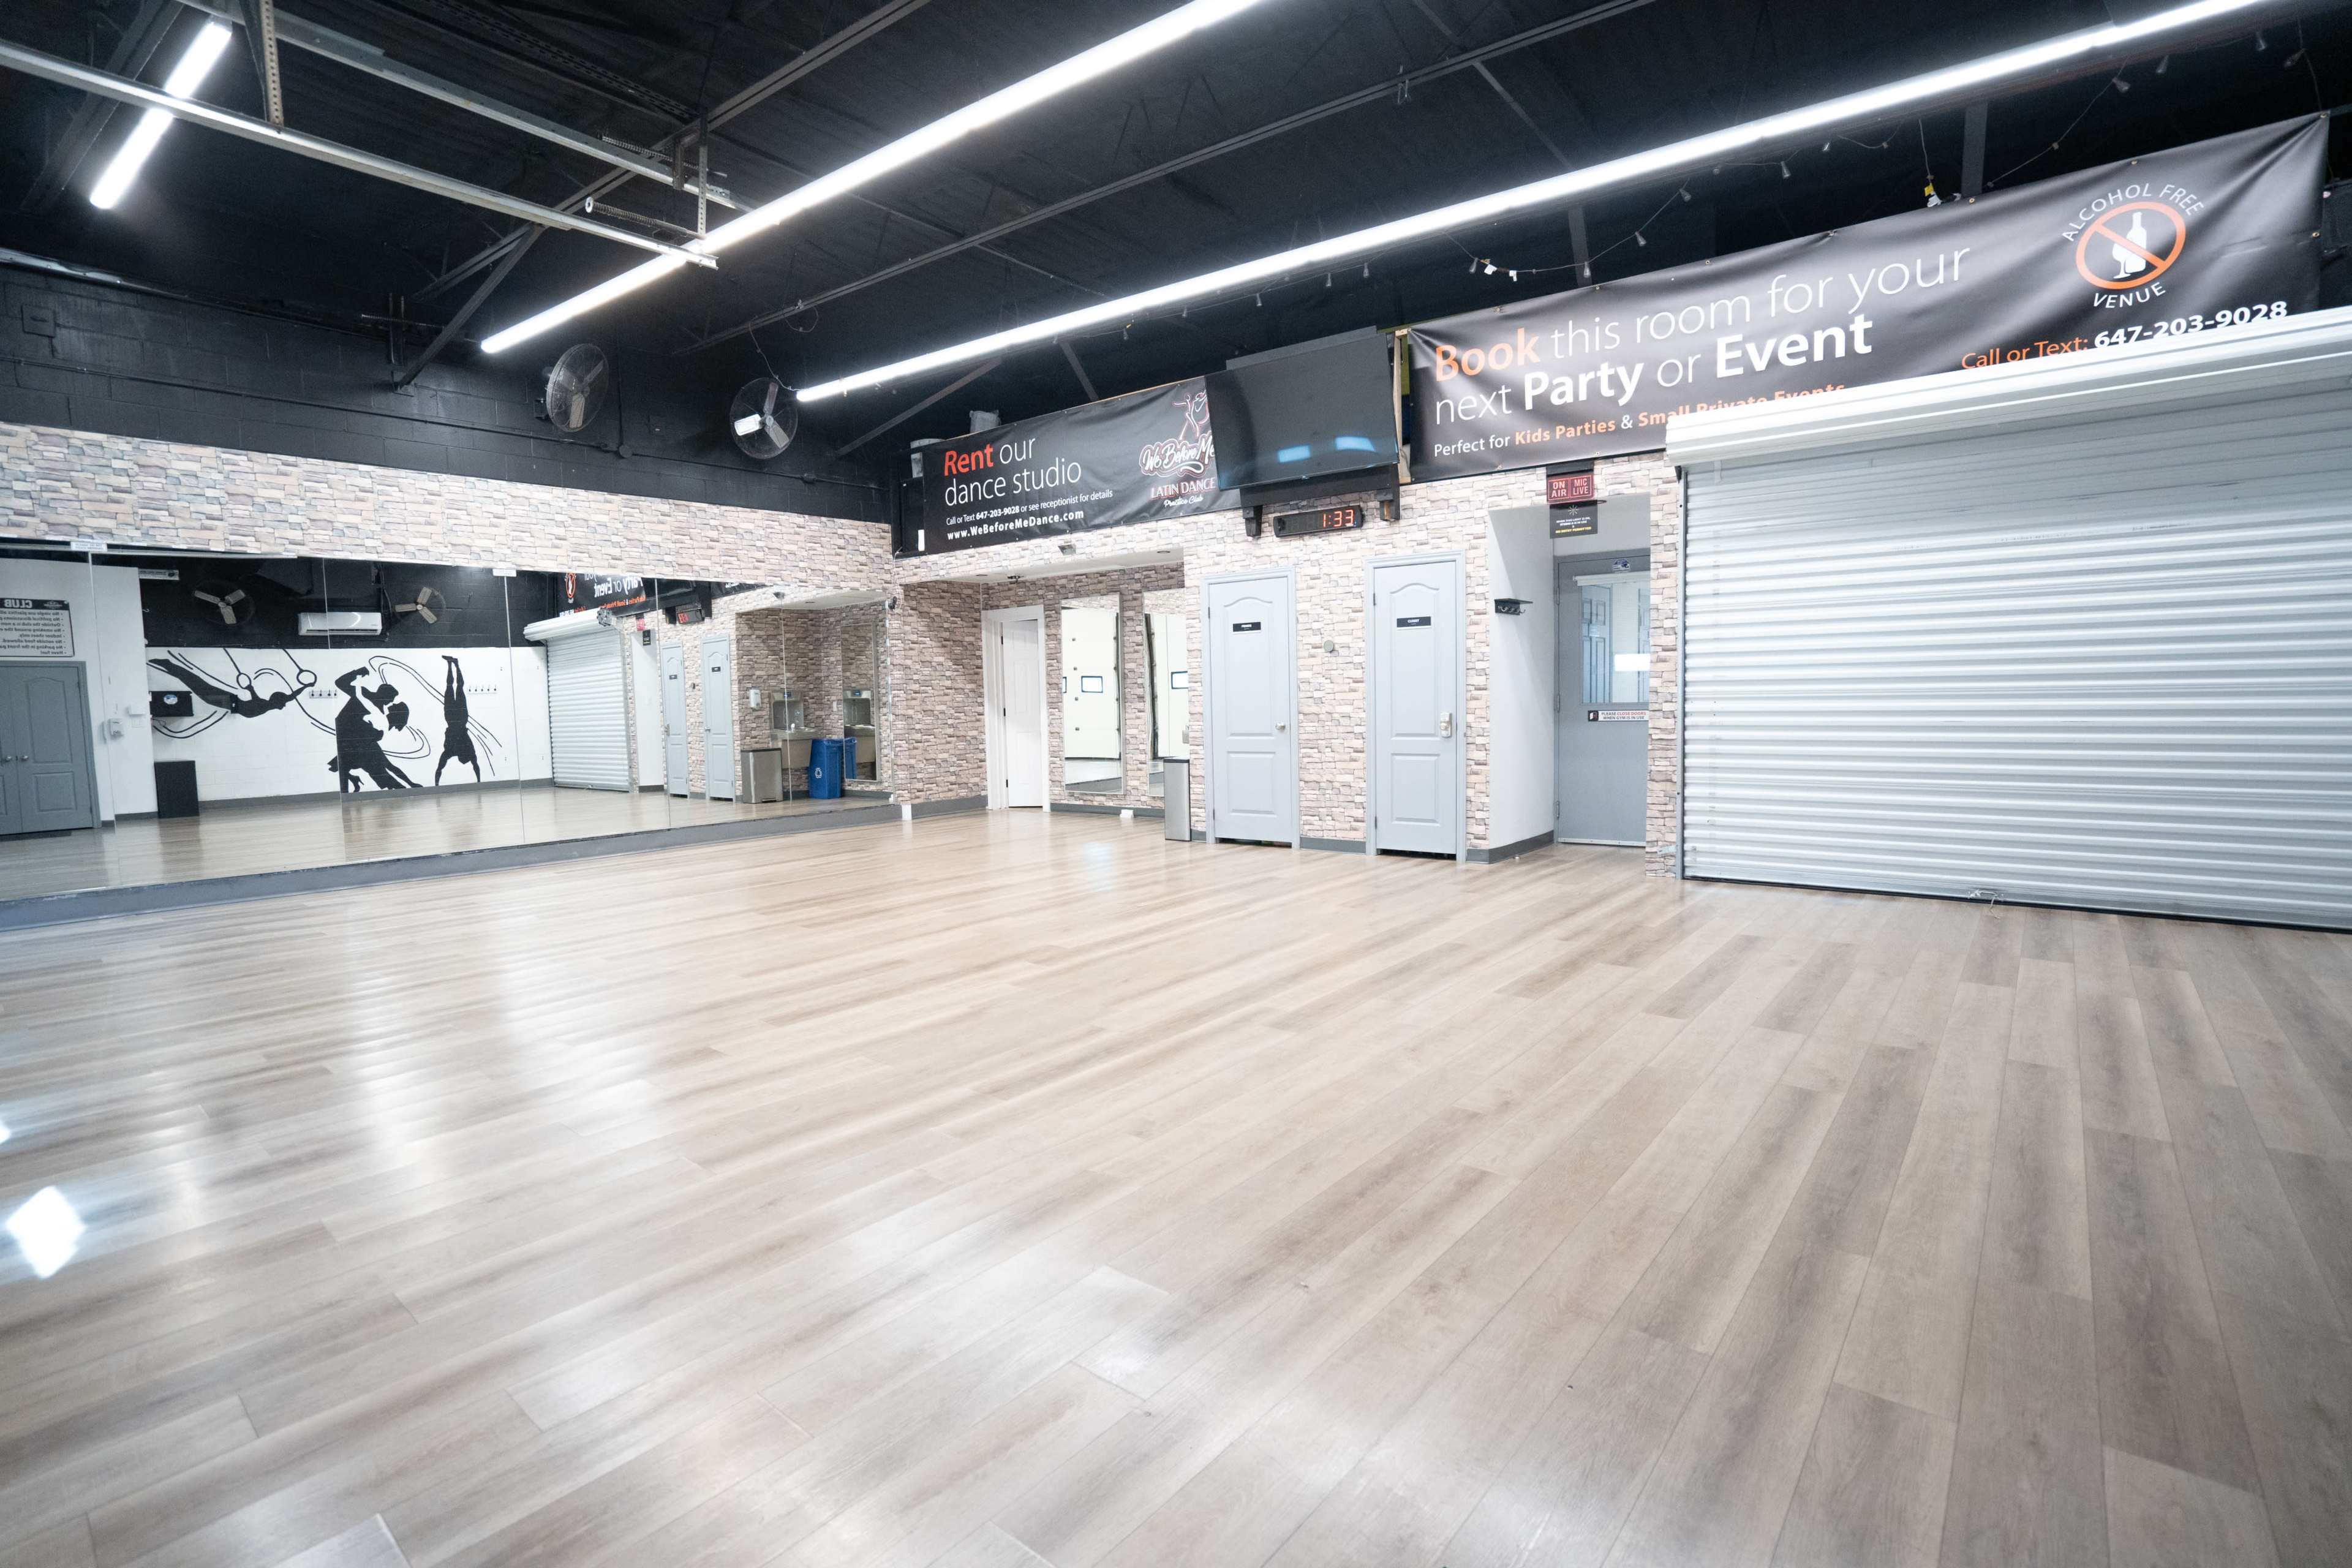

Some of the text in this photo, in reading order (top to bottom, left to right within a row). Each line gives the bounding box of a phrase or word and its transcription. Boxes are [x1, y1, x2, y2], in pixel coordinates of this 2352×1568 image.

[2062, 183, 2204, 241] ALCOHOL FREE
[2093, 281, 2166, 308] VENUE
[1435, 247, 1970, 382] Book this room for your
[1961, 349, 2000, 369] Call
[2007, 344, 2029, 363] or
[2094, 301, 2288, 349] 647-203-9028
[1436, 314, 1873, 425] next Party or Event
[1434, 438, 1485, 458] Perfect
[1490, 434, 1510, 450] for
[1515, 428, 1550, 446] Kids
[1556, 419, 1616, 440] Parties
[1621, 415, 1633, 429] &
[944, 437, 1036, 477] Rent our
[1142, 435, 1215, 472] We Before Me
[945, 457, 1082, 506] dance studio
[1151, 477, 1216, 498] LATIN DANCE
[1553, 481, 1565, 490] ON
[1573, 486, 1588, 495] LIVE
[1574, 478, 1587, 487] MIC
[976, 505, 1020, 520] 647-203-9028
[1028, 503, 1039, 511] see
[1040, 496, 1079, 509] receptionist
[1080, 493, 1089, 502] for
[1090, 489, 1113, 500] details
[1163, 494, 1204, 508] Practice Club
[947, 510, 1084, 540] www.WeBeforeMeDance.com
[1323, 510, 1354, 527] 1:33
